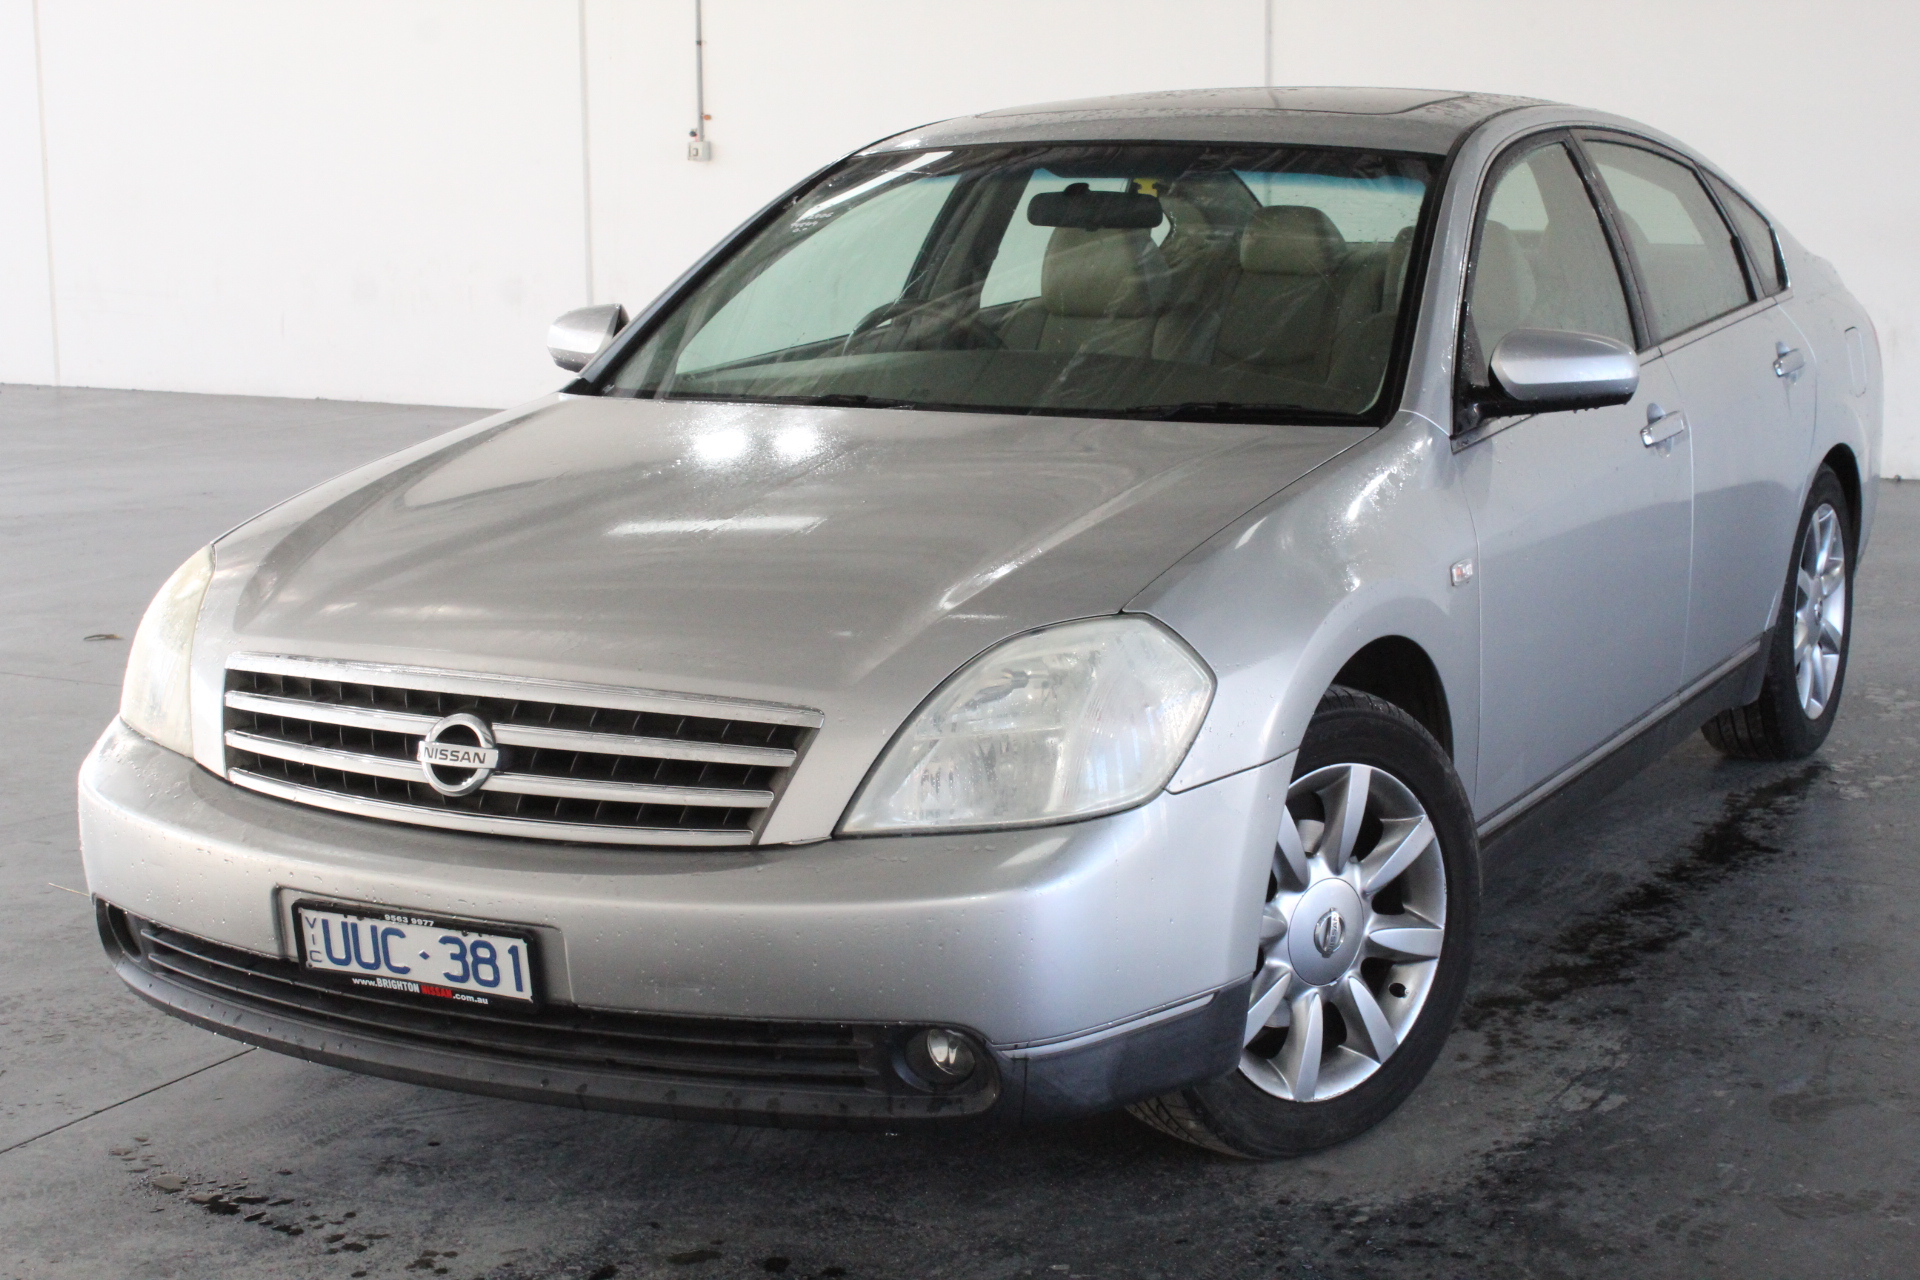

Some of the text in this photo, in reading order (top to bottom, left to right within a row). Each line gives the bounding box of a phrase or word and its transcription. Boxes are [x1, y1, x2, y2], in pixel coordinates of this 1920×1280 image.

[424, 746, 486, 764] NISSAN
[384, 914, 434, 927] 9563 9977
[305, 916, 322, 963] VIC
